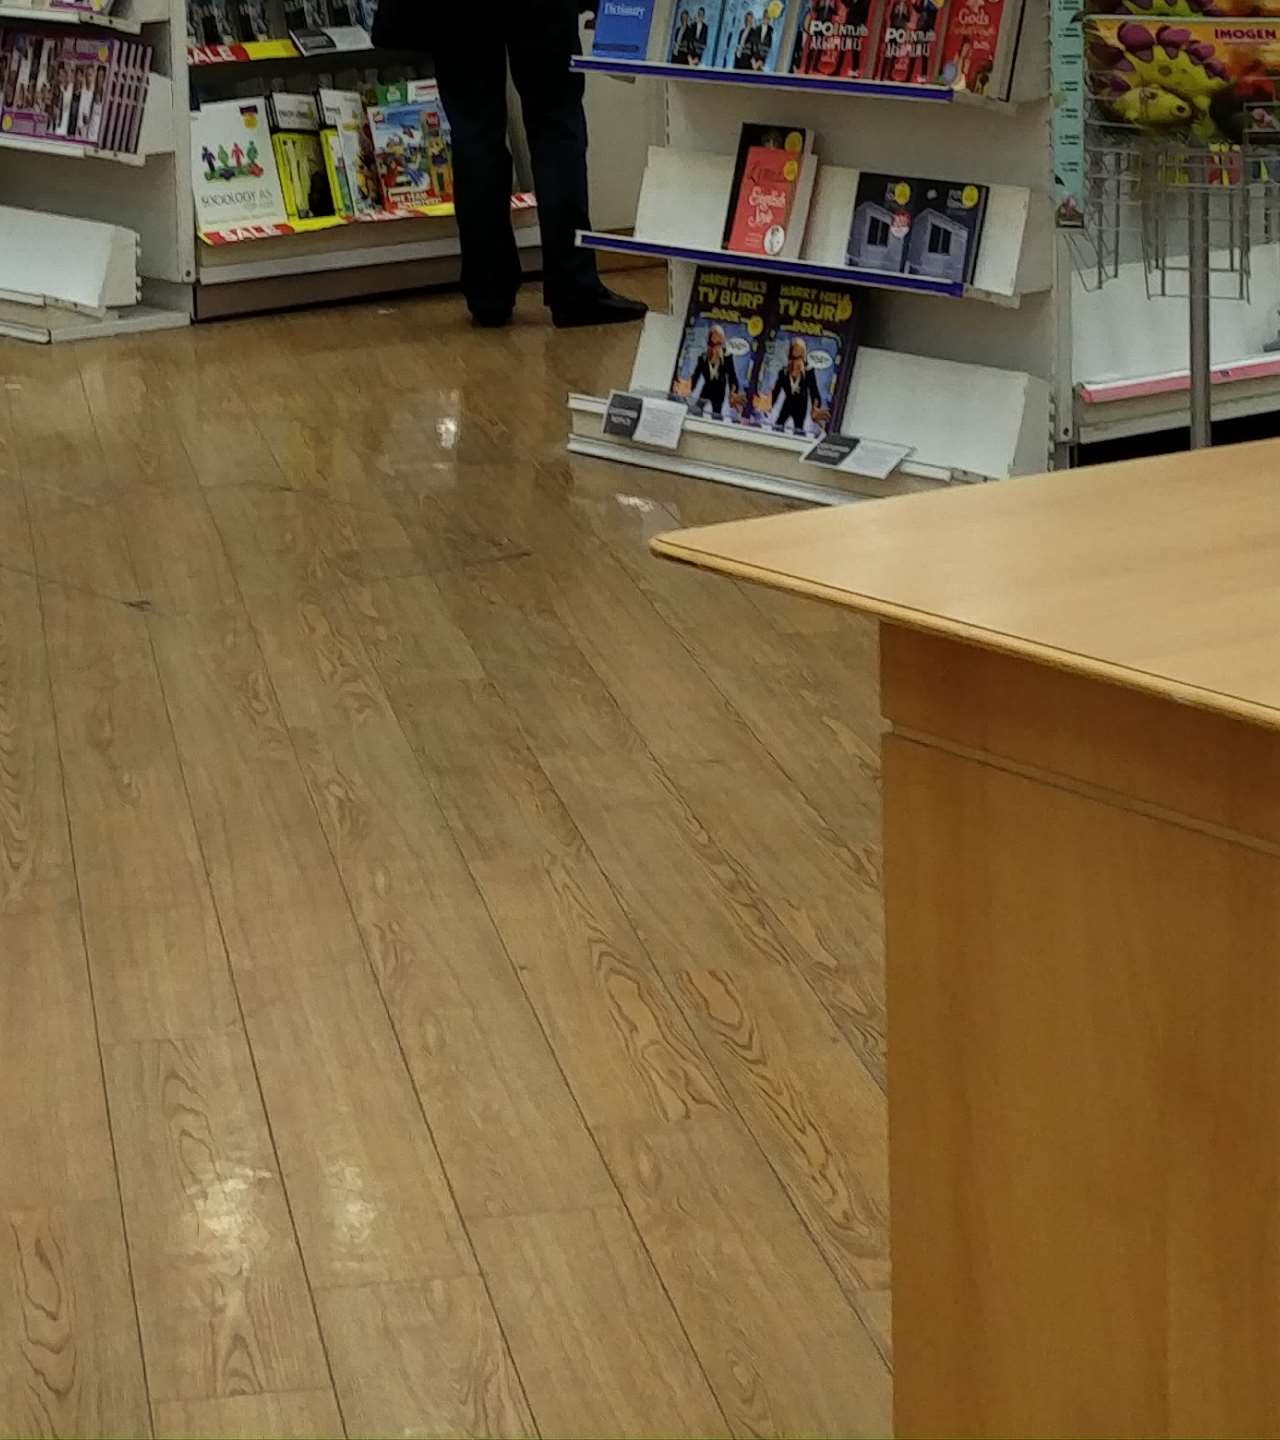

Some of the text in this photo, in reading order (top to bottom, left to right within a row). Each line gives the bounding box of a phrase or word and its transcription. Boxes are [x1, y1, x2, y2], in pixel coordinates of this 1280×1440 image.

[603, 2, 646, 20] Dictionary
[958, 9, 990, 25] Gods
[1214, 27, 1278, 41] IMOGEN
[186, 45, 234, 64] SALE
[220, 225, 284, 244] SALE
[697, 286, 764, 310] TV BURP
[778, 298, 800, 317] TV
